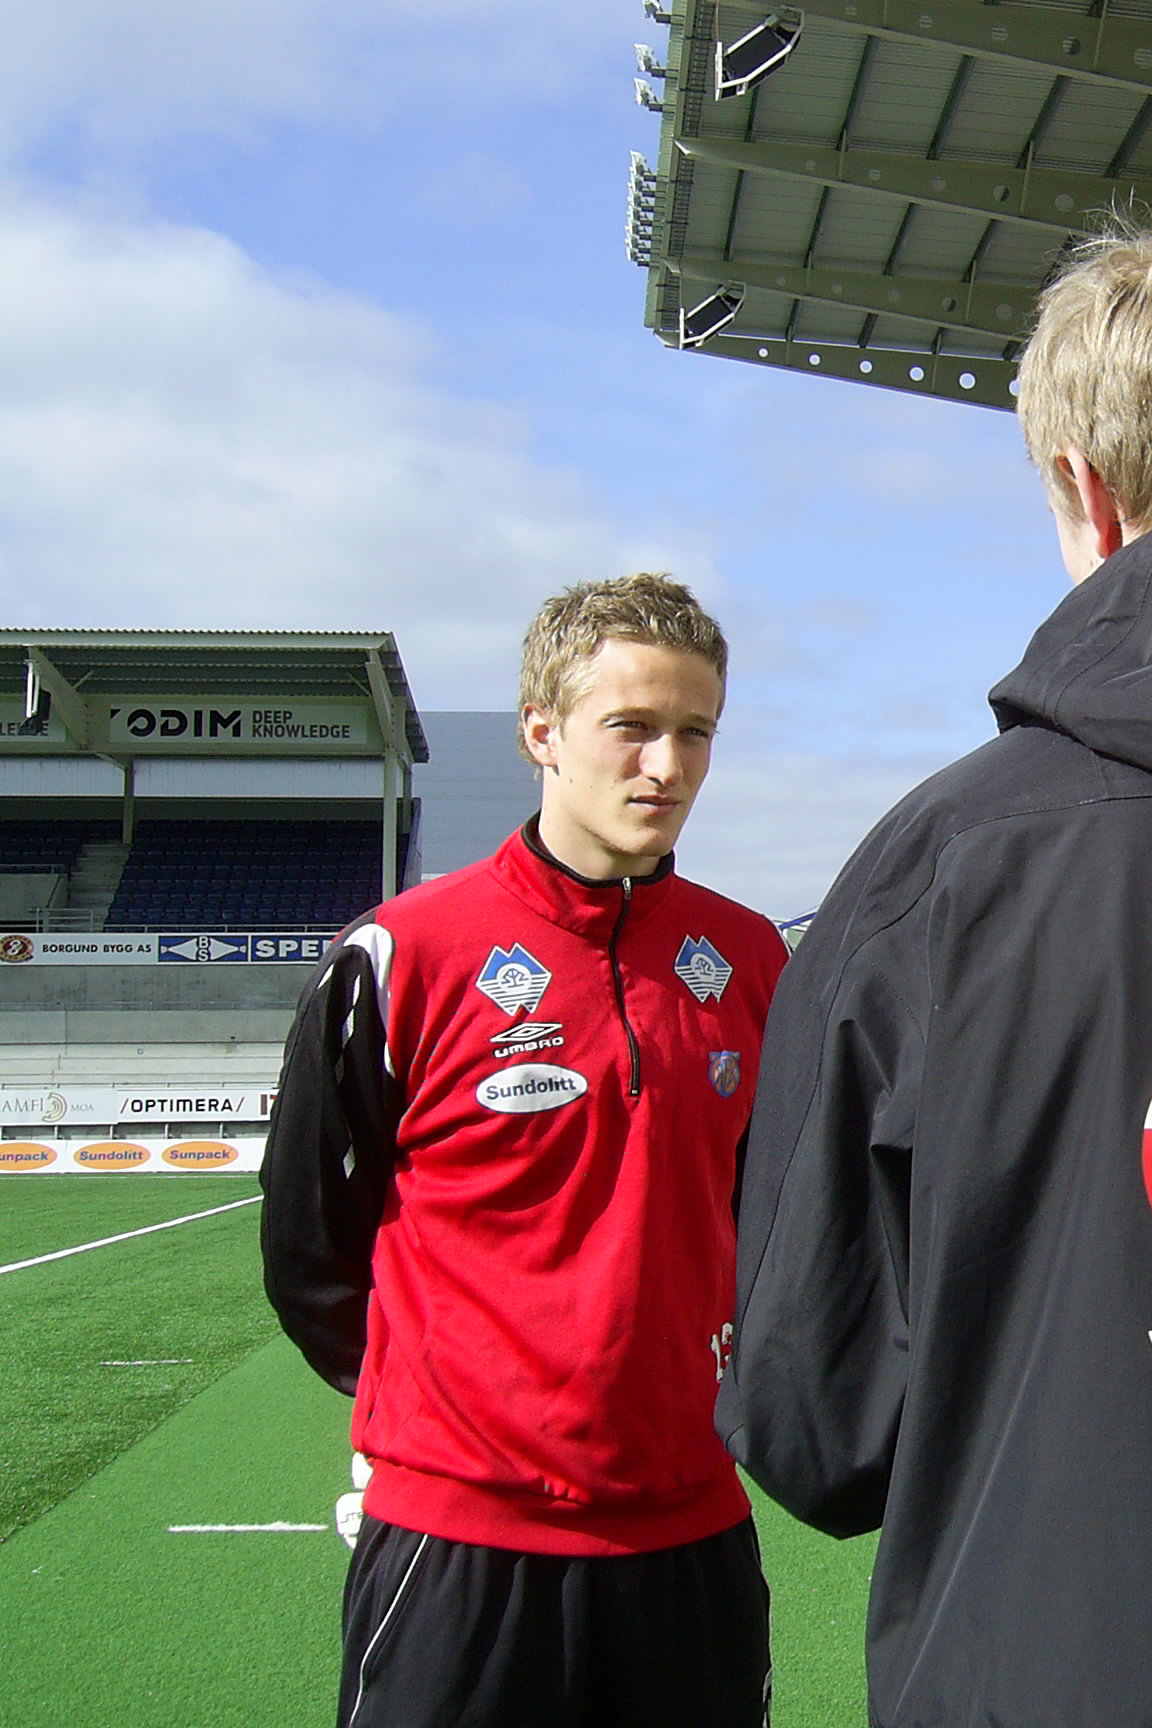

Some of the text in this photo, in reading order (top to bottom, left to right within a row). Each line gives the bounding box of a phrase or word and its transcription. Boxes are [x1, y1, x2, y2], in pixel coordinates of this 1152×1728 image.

[252, 710, 293, 724] DEEP
[252, 724, 351, 738] KNOWLEDGE
[42, 943, 152, 954] BORGUND BYGG AS
[255, 939, 334, 958] SPE
[486, 1076, 577, 1100] Sundolitt
[70, 1103, 95, 1113] MOA
[79, 1151, 143, 1161] Sundolitt
[169, 1150, 230, 1161] Sunpack
